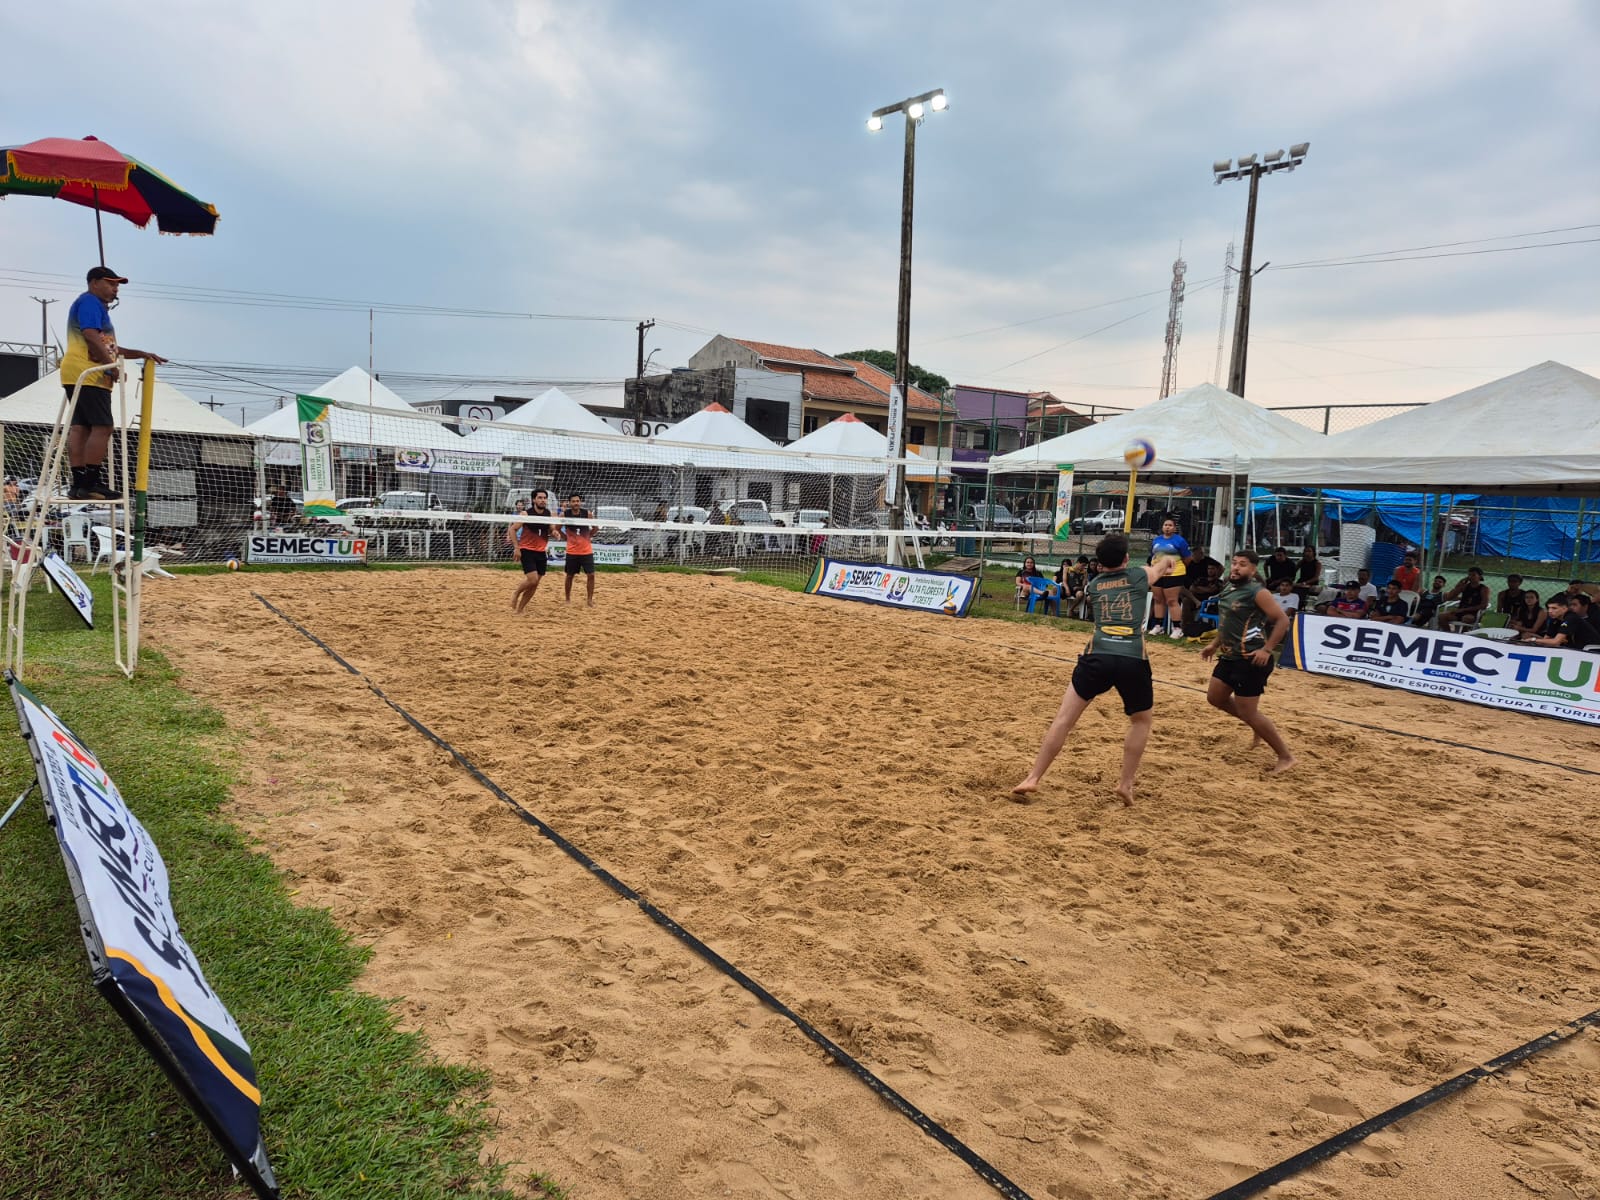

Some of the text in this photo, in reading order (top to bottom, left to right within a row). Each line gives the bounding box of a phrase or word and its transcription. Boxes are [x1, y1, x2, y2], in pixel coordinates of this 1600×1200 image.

[252, 537, 366, 555] SEMECTUR
[850, 569, 892, 588] SEMECTUR
[1096, 577, 1132, 591] GABRIEL
[908, 584, 945, 597] ALTA FLORESTA
[1098, 591, 1133, 622] 14
[1320, 623, 1600, 693] SEMECTU
[1351, 656, 1386, 666] ESPORTE
[1429, 670, 1467, 682] CULTURA
[1317, 664, 1386, 681] SECRETÁRIA
[1408, 680, 1466, 698] ESPORTE,
[1470, 693, 1534, 709] CULTURA
[1554, 706, 1600, 720] TURIS
[1529, 688, 1572, 699] TURISMO
[52, 730, 209, 999] SEMECTUR
